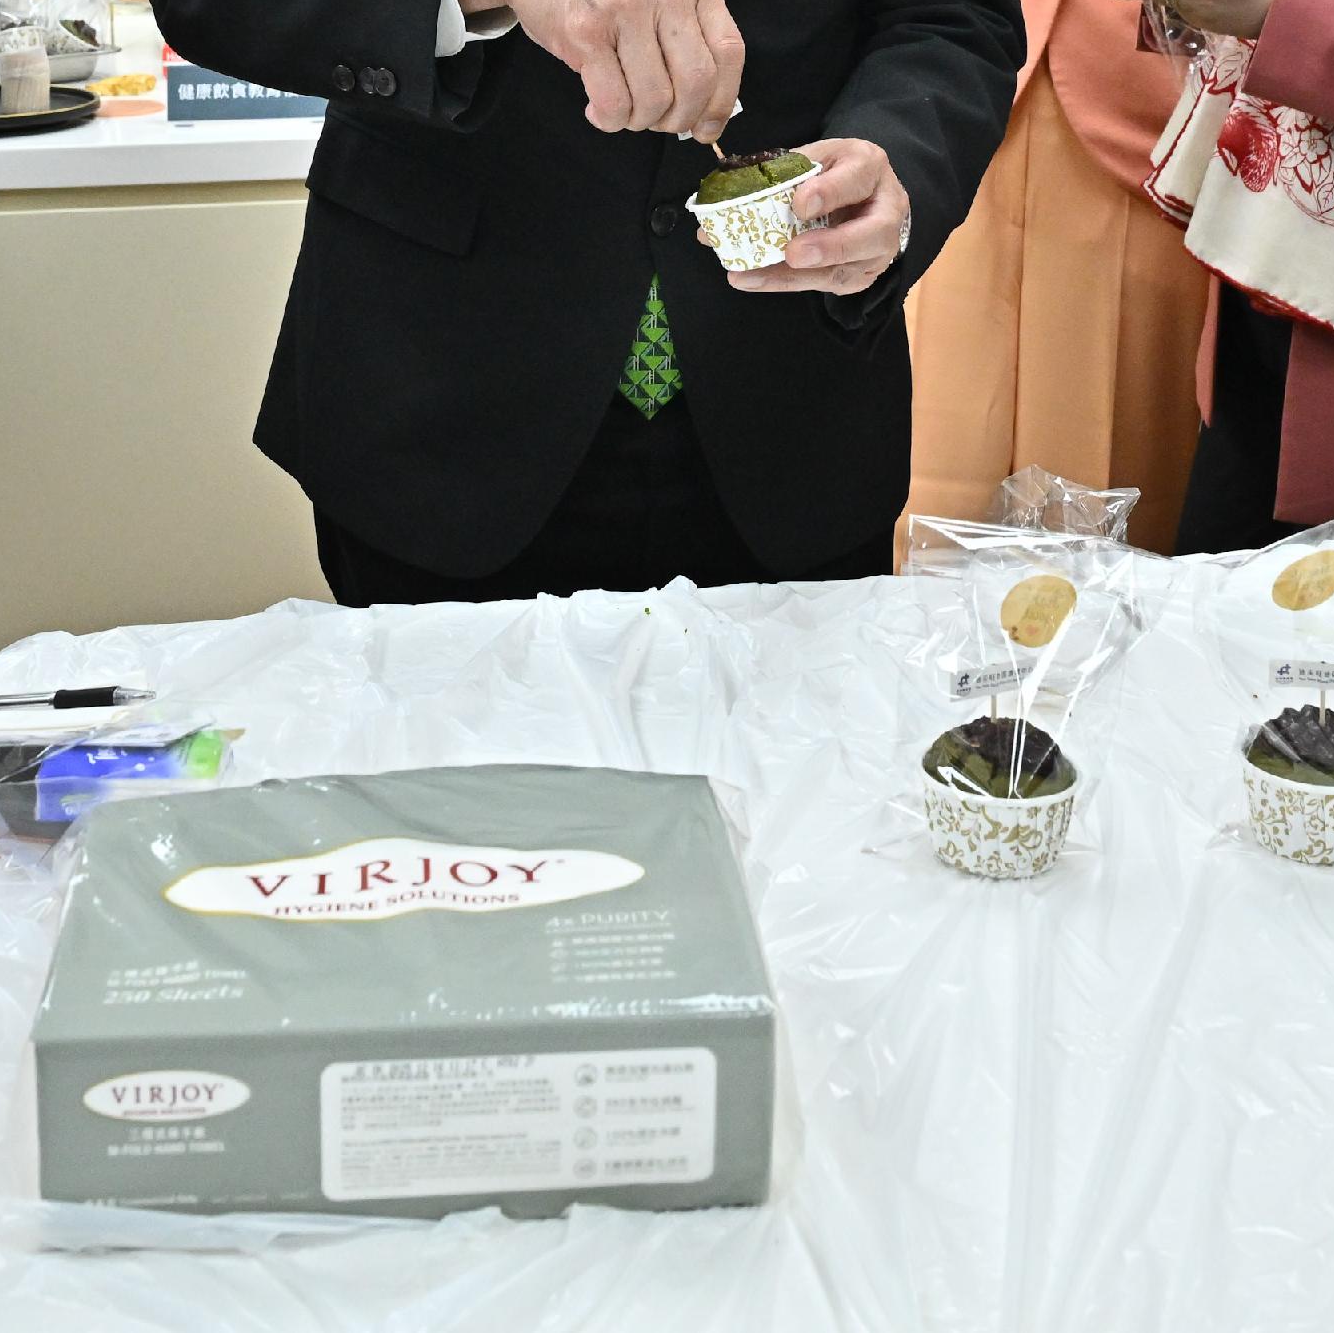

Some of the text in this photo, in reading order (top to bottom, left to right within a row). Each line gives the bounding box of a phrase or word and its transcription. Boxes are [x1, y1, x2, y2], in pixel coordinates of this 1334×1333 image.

[247, 858, 547, 898] VIRJOY
[275, 891, 519, 916] HYGIENE SOLUTIONS
[112, 1084, 218, 1105] VIRJOY
